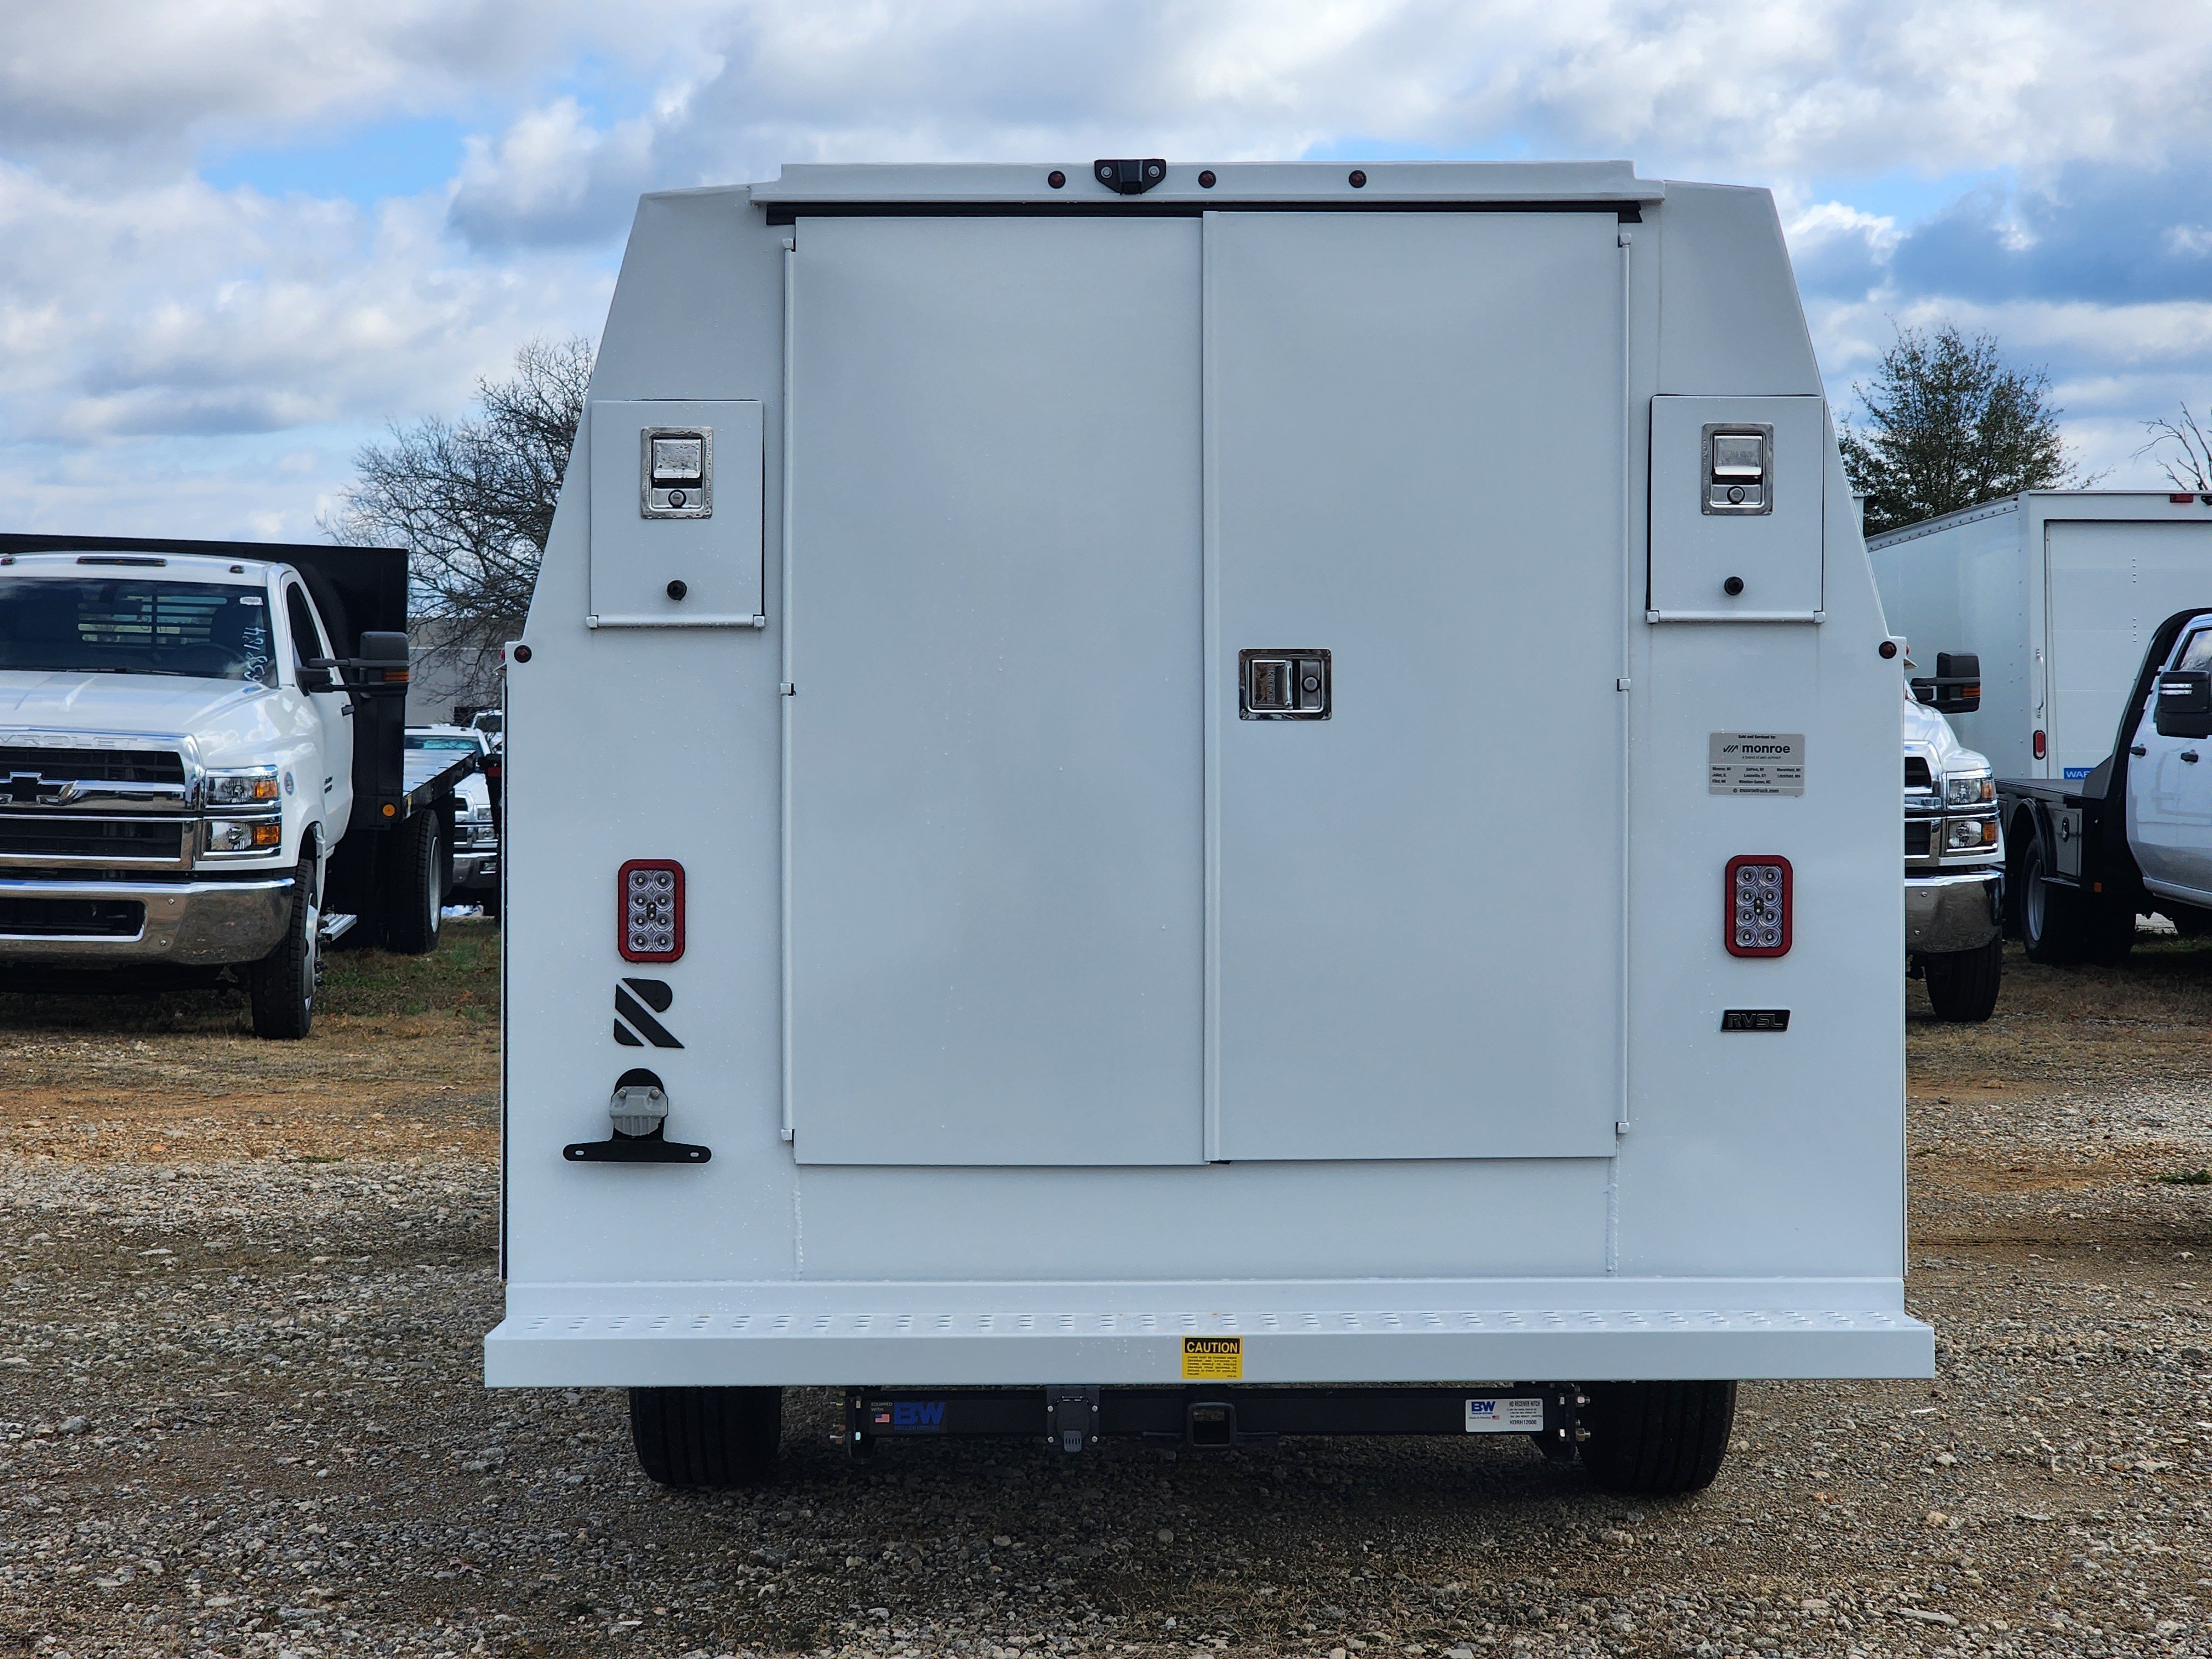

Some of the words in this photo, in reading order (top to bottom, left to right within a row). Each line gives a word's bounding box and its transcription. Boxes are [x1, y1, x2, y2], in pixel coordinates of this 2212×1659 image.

[1743, 745, 1790, 753] monroe
[1728, 1014, 1783, 1027] RVSL
[1187, 1342, 1238, 1353] CAUTION
